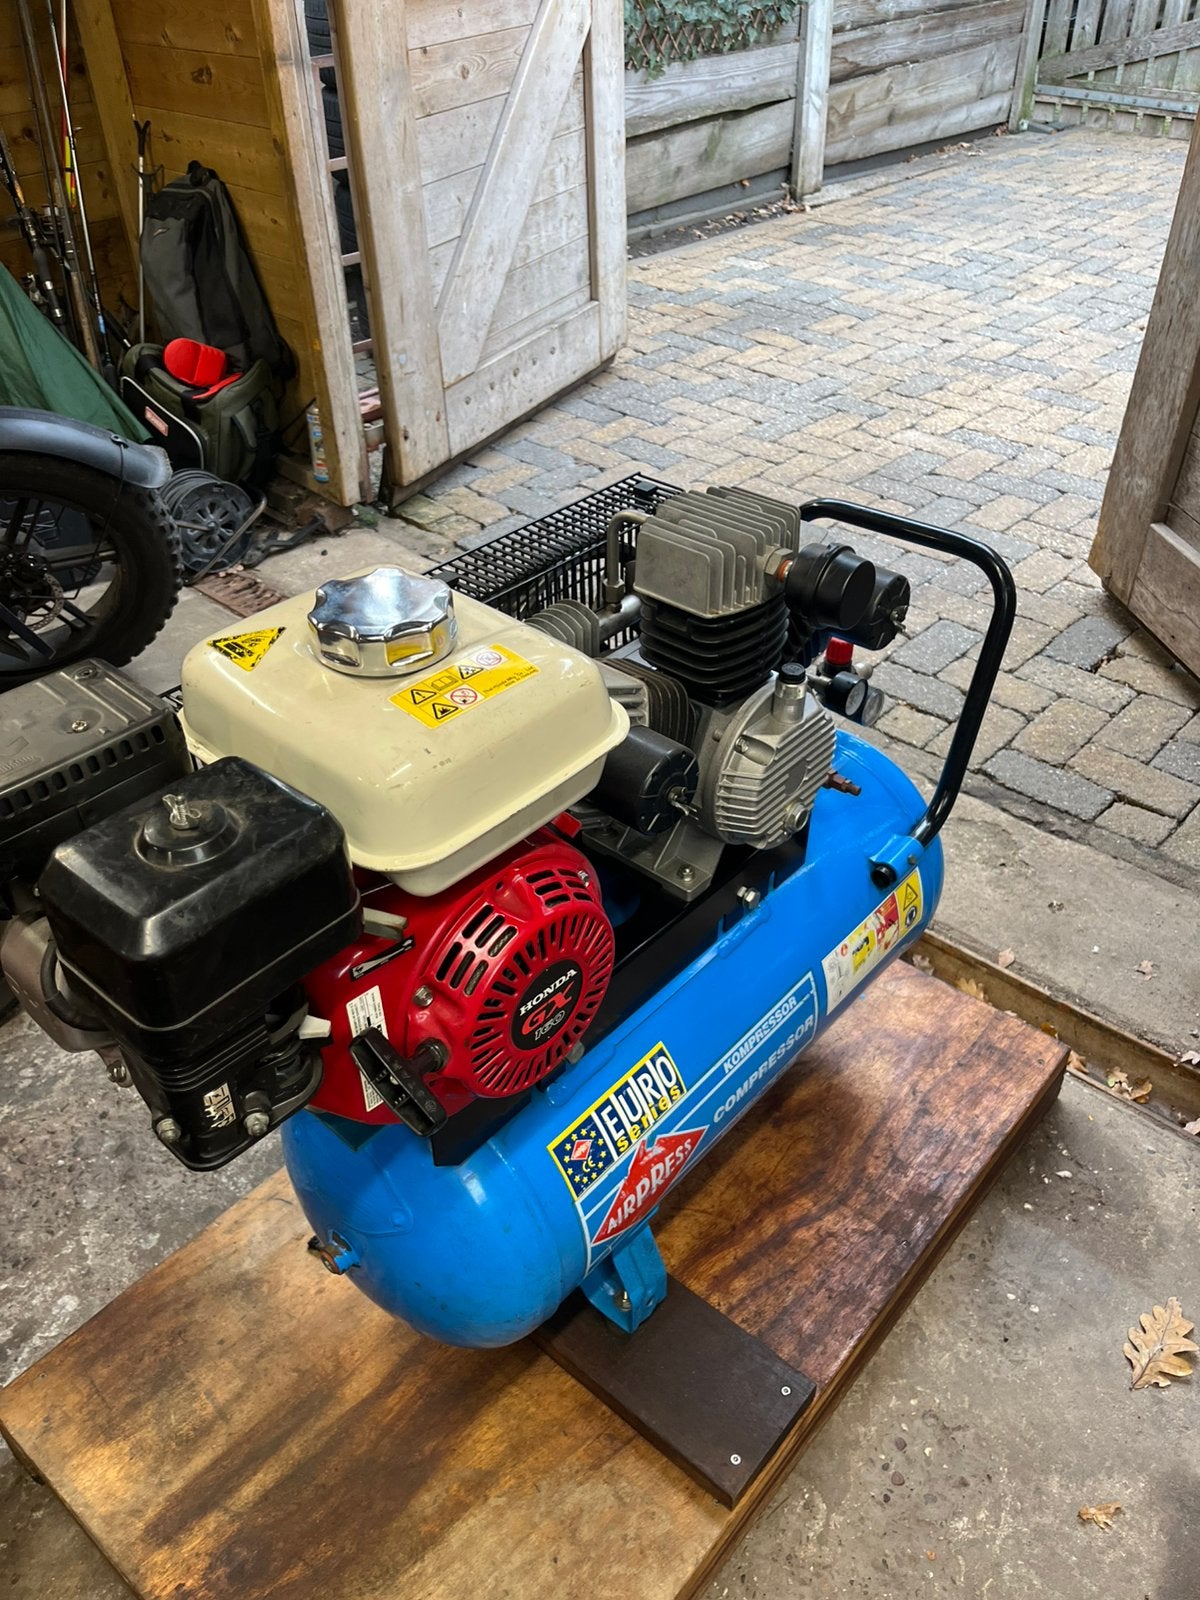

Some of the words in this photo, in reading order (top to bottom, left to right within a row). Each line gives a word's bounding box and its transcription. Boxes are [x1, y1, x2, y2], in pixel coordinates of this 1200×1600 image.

[520, 969, 577, 1016] HONDA
[522, 981, 574, 1035] GX
[535, 1010, 565, 1040] 160
[713, 1014, 813, 1123] COMPRESSOR
[723, 996, 797, 1073] KOMPRESSOR
[600, 1056, 677, 1140] EURO
[617, 1085, 681, 1152] series
[607, 1139, 692, 1234] AIRPRESS
